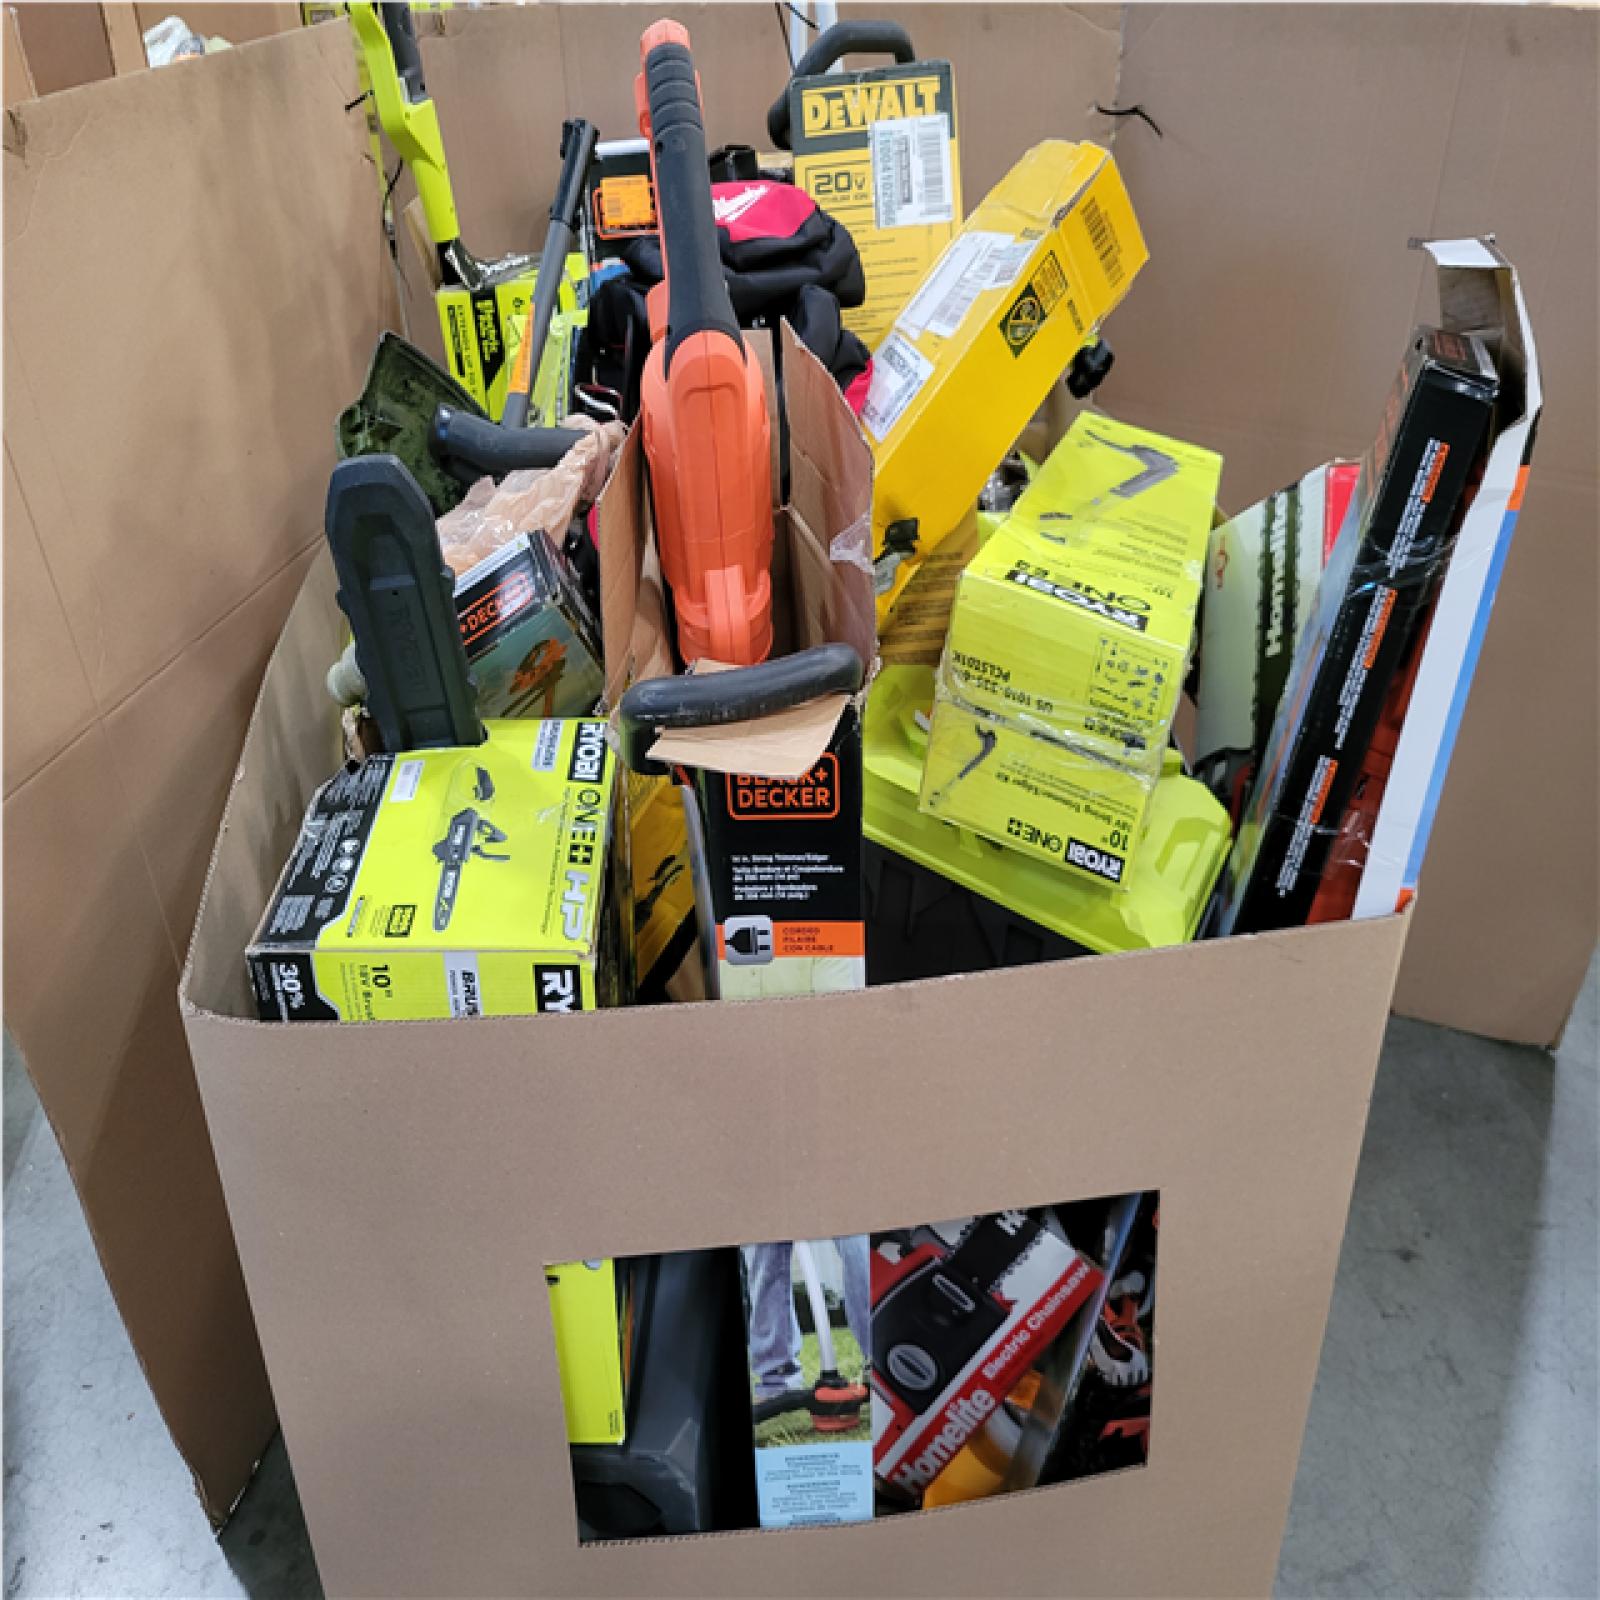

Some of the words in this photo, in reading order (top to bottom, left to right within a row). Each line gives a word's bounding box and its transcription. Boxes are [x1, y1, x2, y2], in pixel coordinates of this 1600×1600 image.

[737, 786, 831, 808] DECKER
[1068, 841, 1122, 880] RYOBI
[560, 870, 590, 940] HP
[982, 1330, 1031, 1378] Electric
[887, 1388, 996, 1491] Homelite
